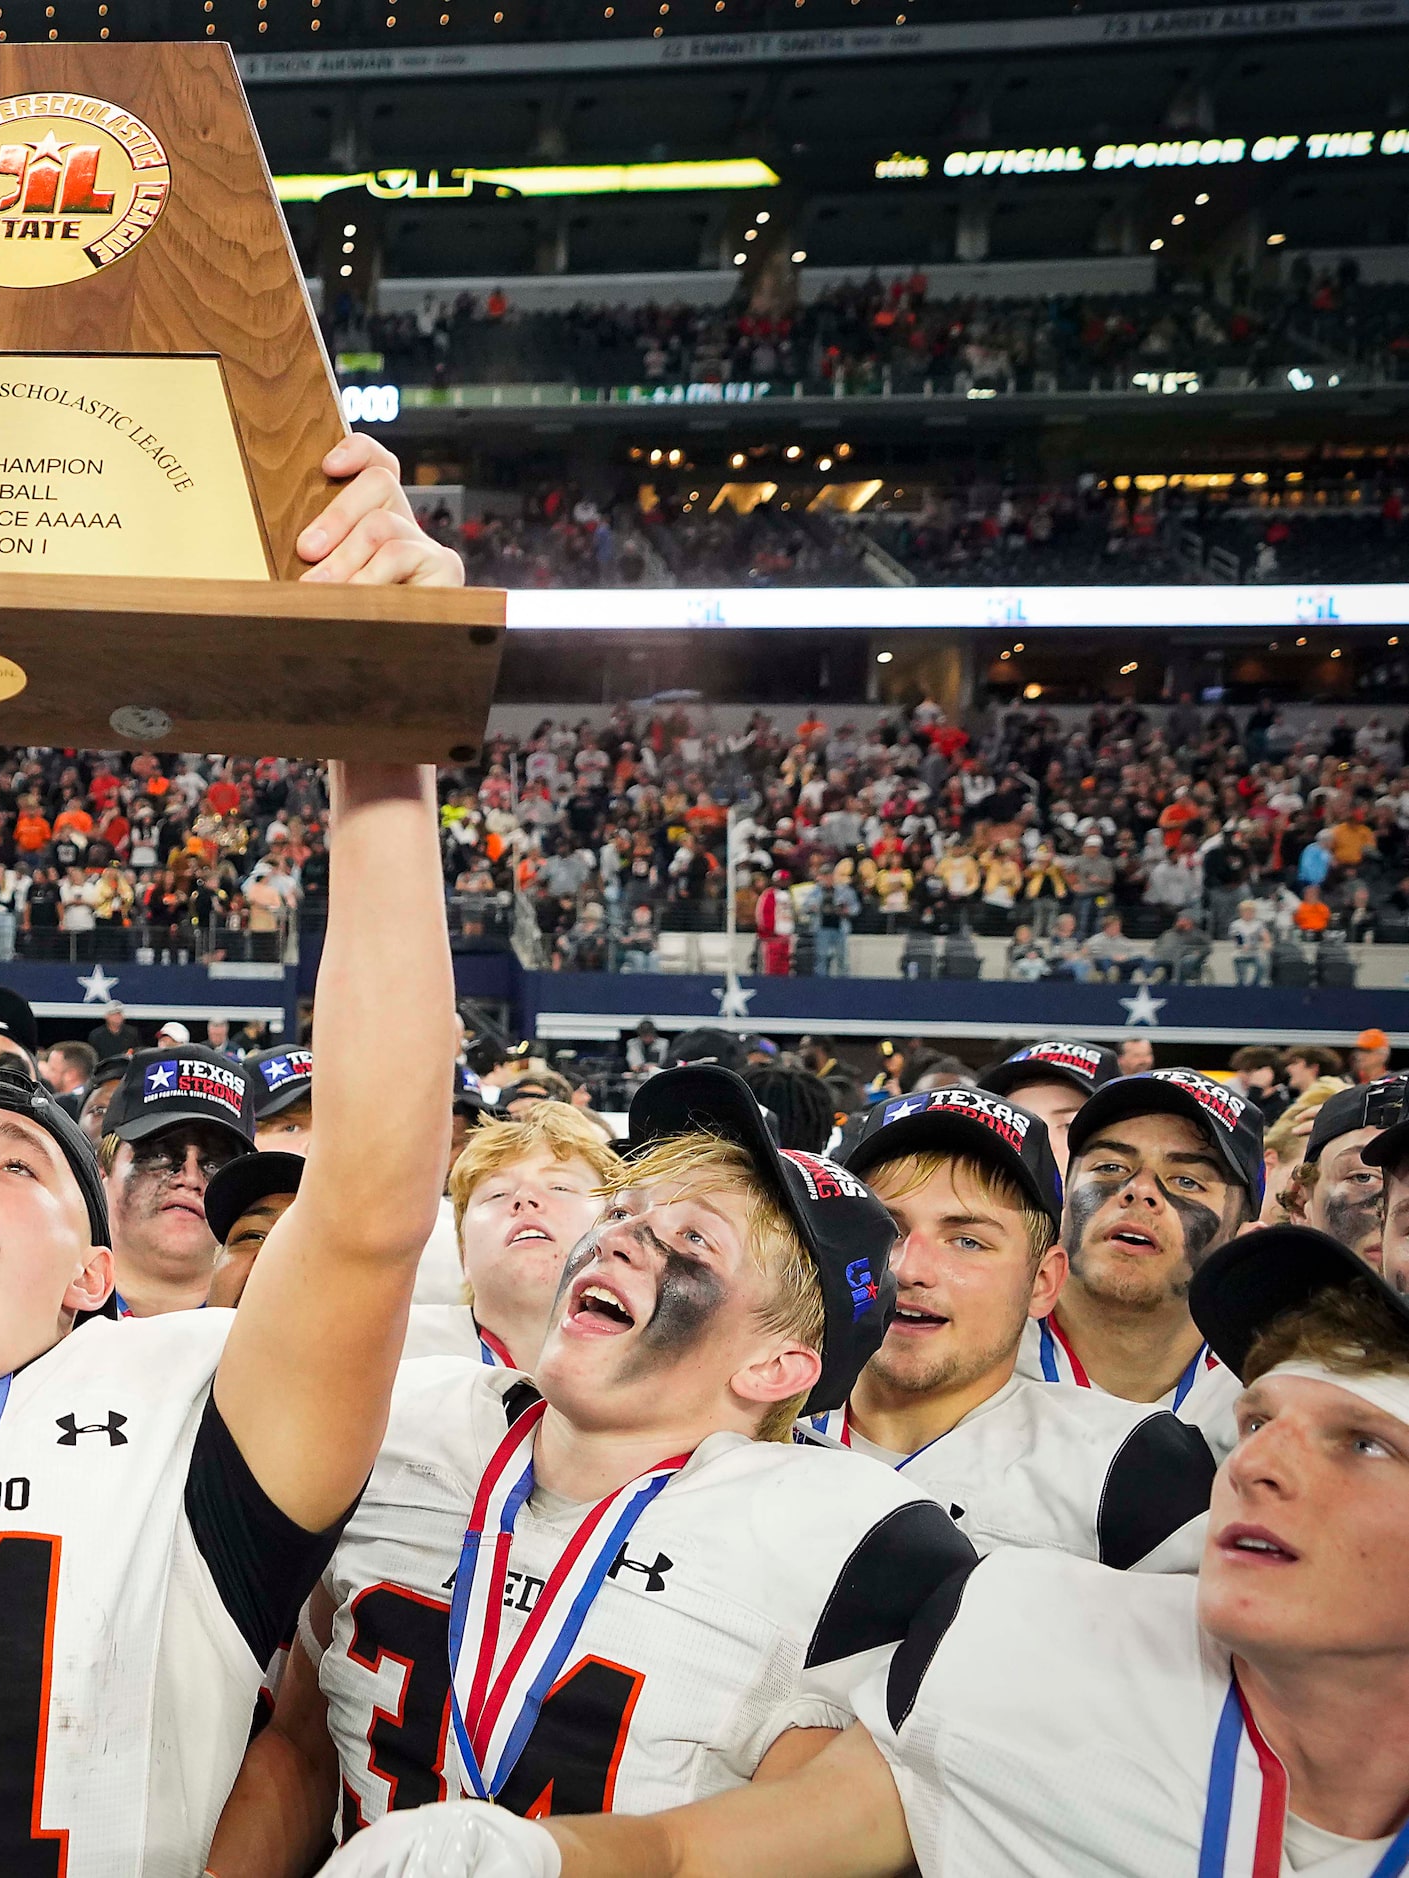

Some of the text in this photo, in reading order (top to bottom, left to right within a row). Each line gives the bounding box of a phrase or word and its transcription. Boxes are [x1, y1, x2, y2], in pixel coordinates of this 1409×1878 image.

[943, 147, 1086, 176] OFFICIAL
[1093, 138, 1247, 170] SPONSOR
[1251, 135, 1300, 162] OF
[1307, 131, 1375, 158] THE
[88, 182, 169, 265] LEAGUE
[127, 425, 195, 495] LEAGUE
[35, 511, 123, 530] AAAAA
[40, 538, 48, 555] I
[1028, 1041, 1102, 1065] TEXAS
[179, 1059, 246, 1097] TEXAS
[179, 1075, 243, 1112] STRONG
[1152, 1070, 1247, 1119] TEXAS
[930, 1089, 1031, 1138] TEXAS
[341, 1581, 646, 1846] 34
